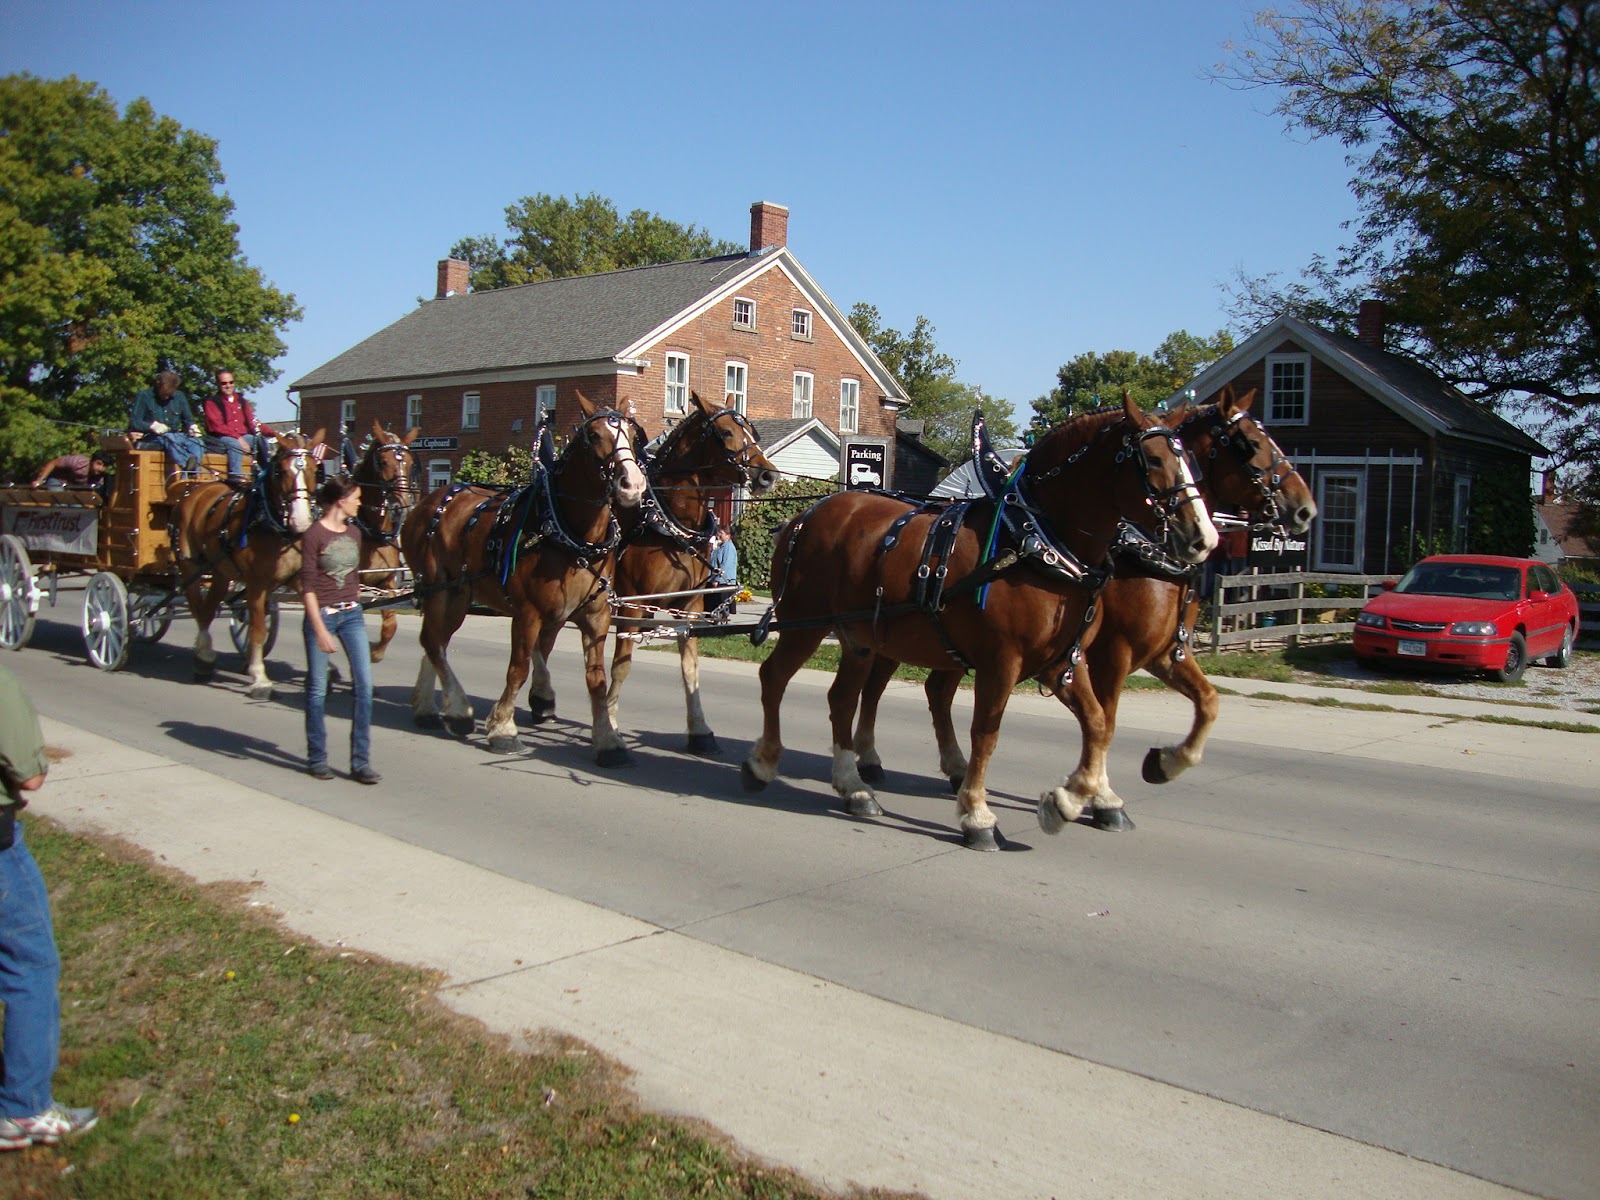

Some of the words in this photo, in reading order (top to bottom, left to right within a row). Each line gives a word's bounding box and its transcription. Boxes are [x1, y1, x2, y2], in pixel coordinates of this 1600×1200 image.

[424, 439, 450, 449] Cupboard
[851, 449, 882, 461] Parking
[1251, 536, 1275, 551] Kissed
[1273, 538, 1284, 556] By
